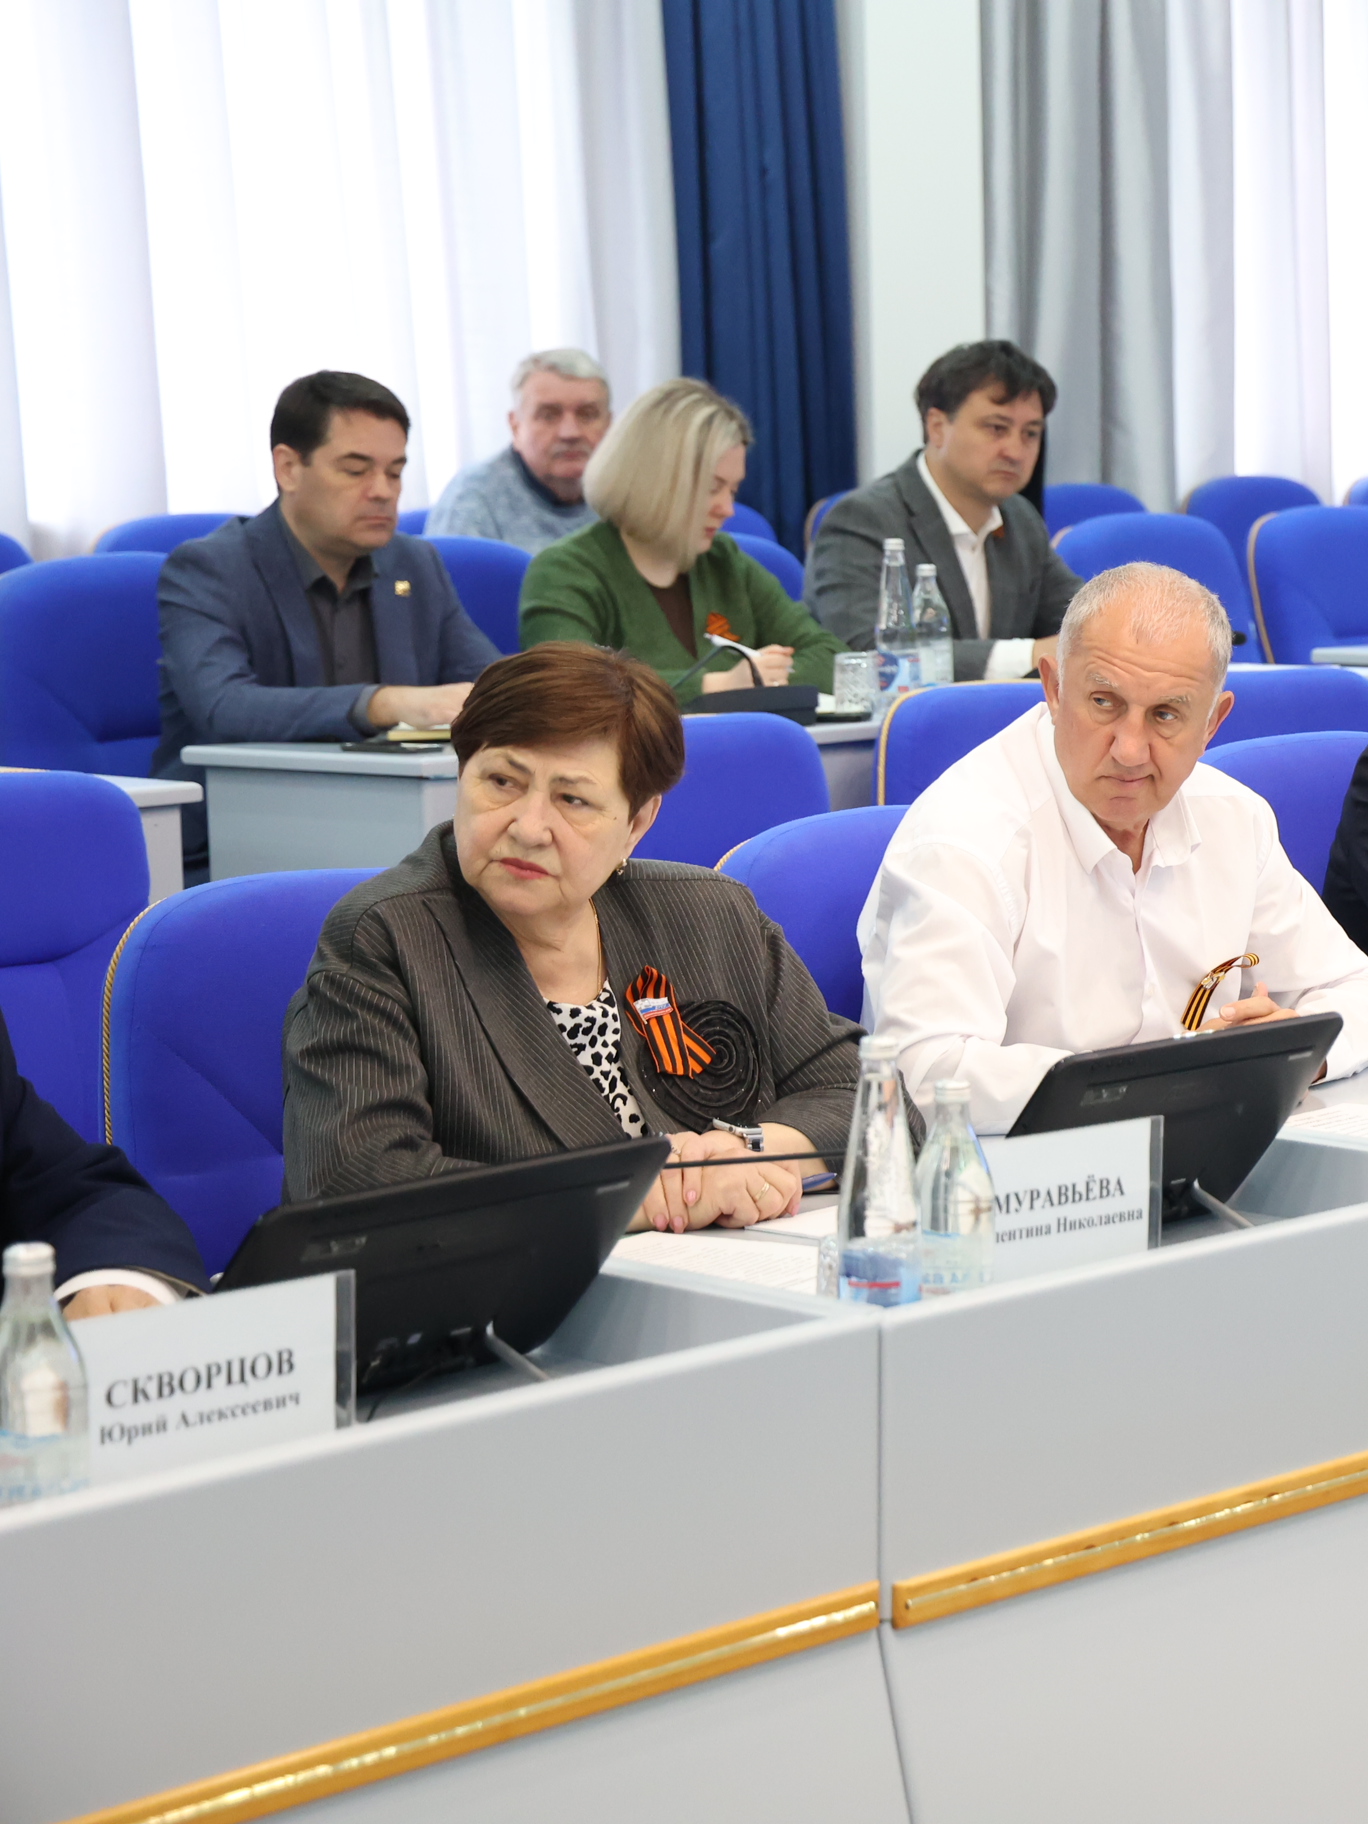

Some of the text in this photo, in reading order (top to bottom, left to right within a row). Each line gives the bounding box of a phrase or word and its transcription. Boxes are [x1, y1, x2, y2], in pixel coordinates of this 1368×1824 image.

[1056, 1208, 1143, 1233] Николаевна
[105, 1348, 295, 1409] СКВОРЦОВ
[100, 1391, 301, 1446] Юрий Алексеевич
